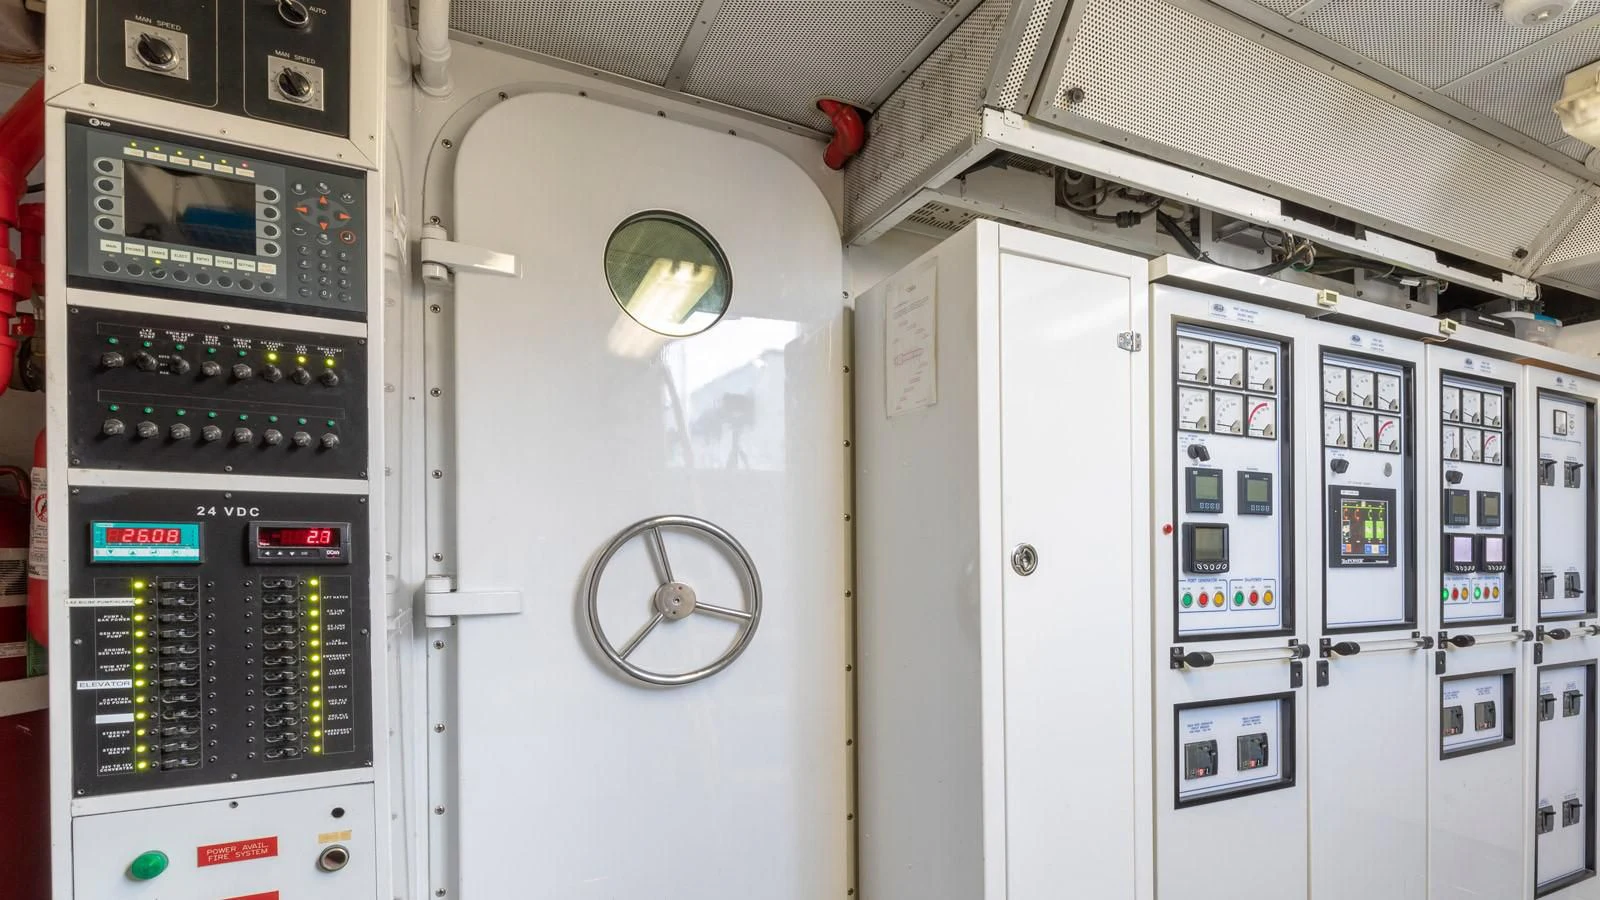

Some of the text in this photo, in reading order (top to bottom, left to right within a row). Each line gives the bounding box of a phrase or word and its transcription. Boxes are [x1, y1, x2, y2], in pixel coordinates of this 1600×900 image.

[309, 6, 327, 15] AUTO
[135, 15, 182, 31] MAN SPEED
[275, 49, 316, 64] MAN SPEED
[196, 506, 260, 517] 24 VDC
[122, 528, 179, 543] 26.08
[79, 680, 130, 688] ELEVATOR
[206, 846, 237, 856] POWER
[208, 848, 268, 862] FIRE SYSTEM
